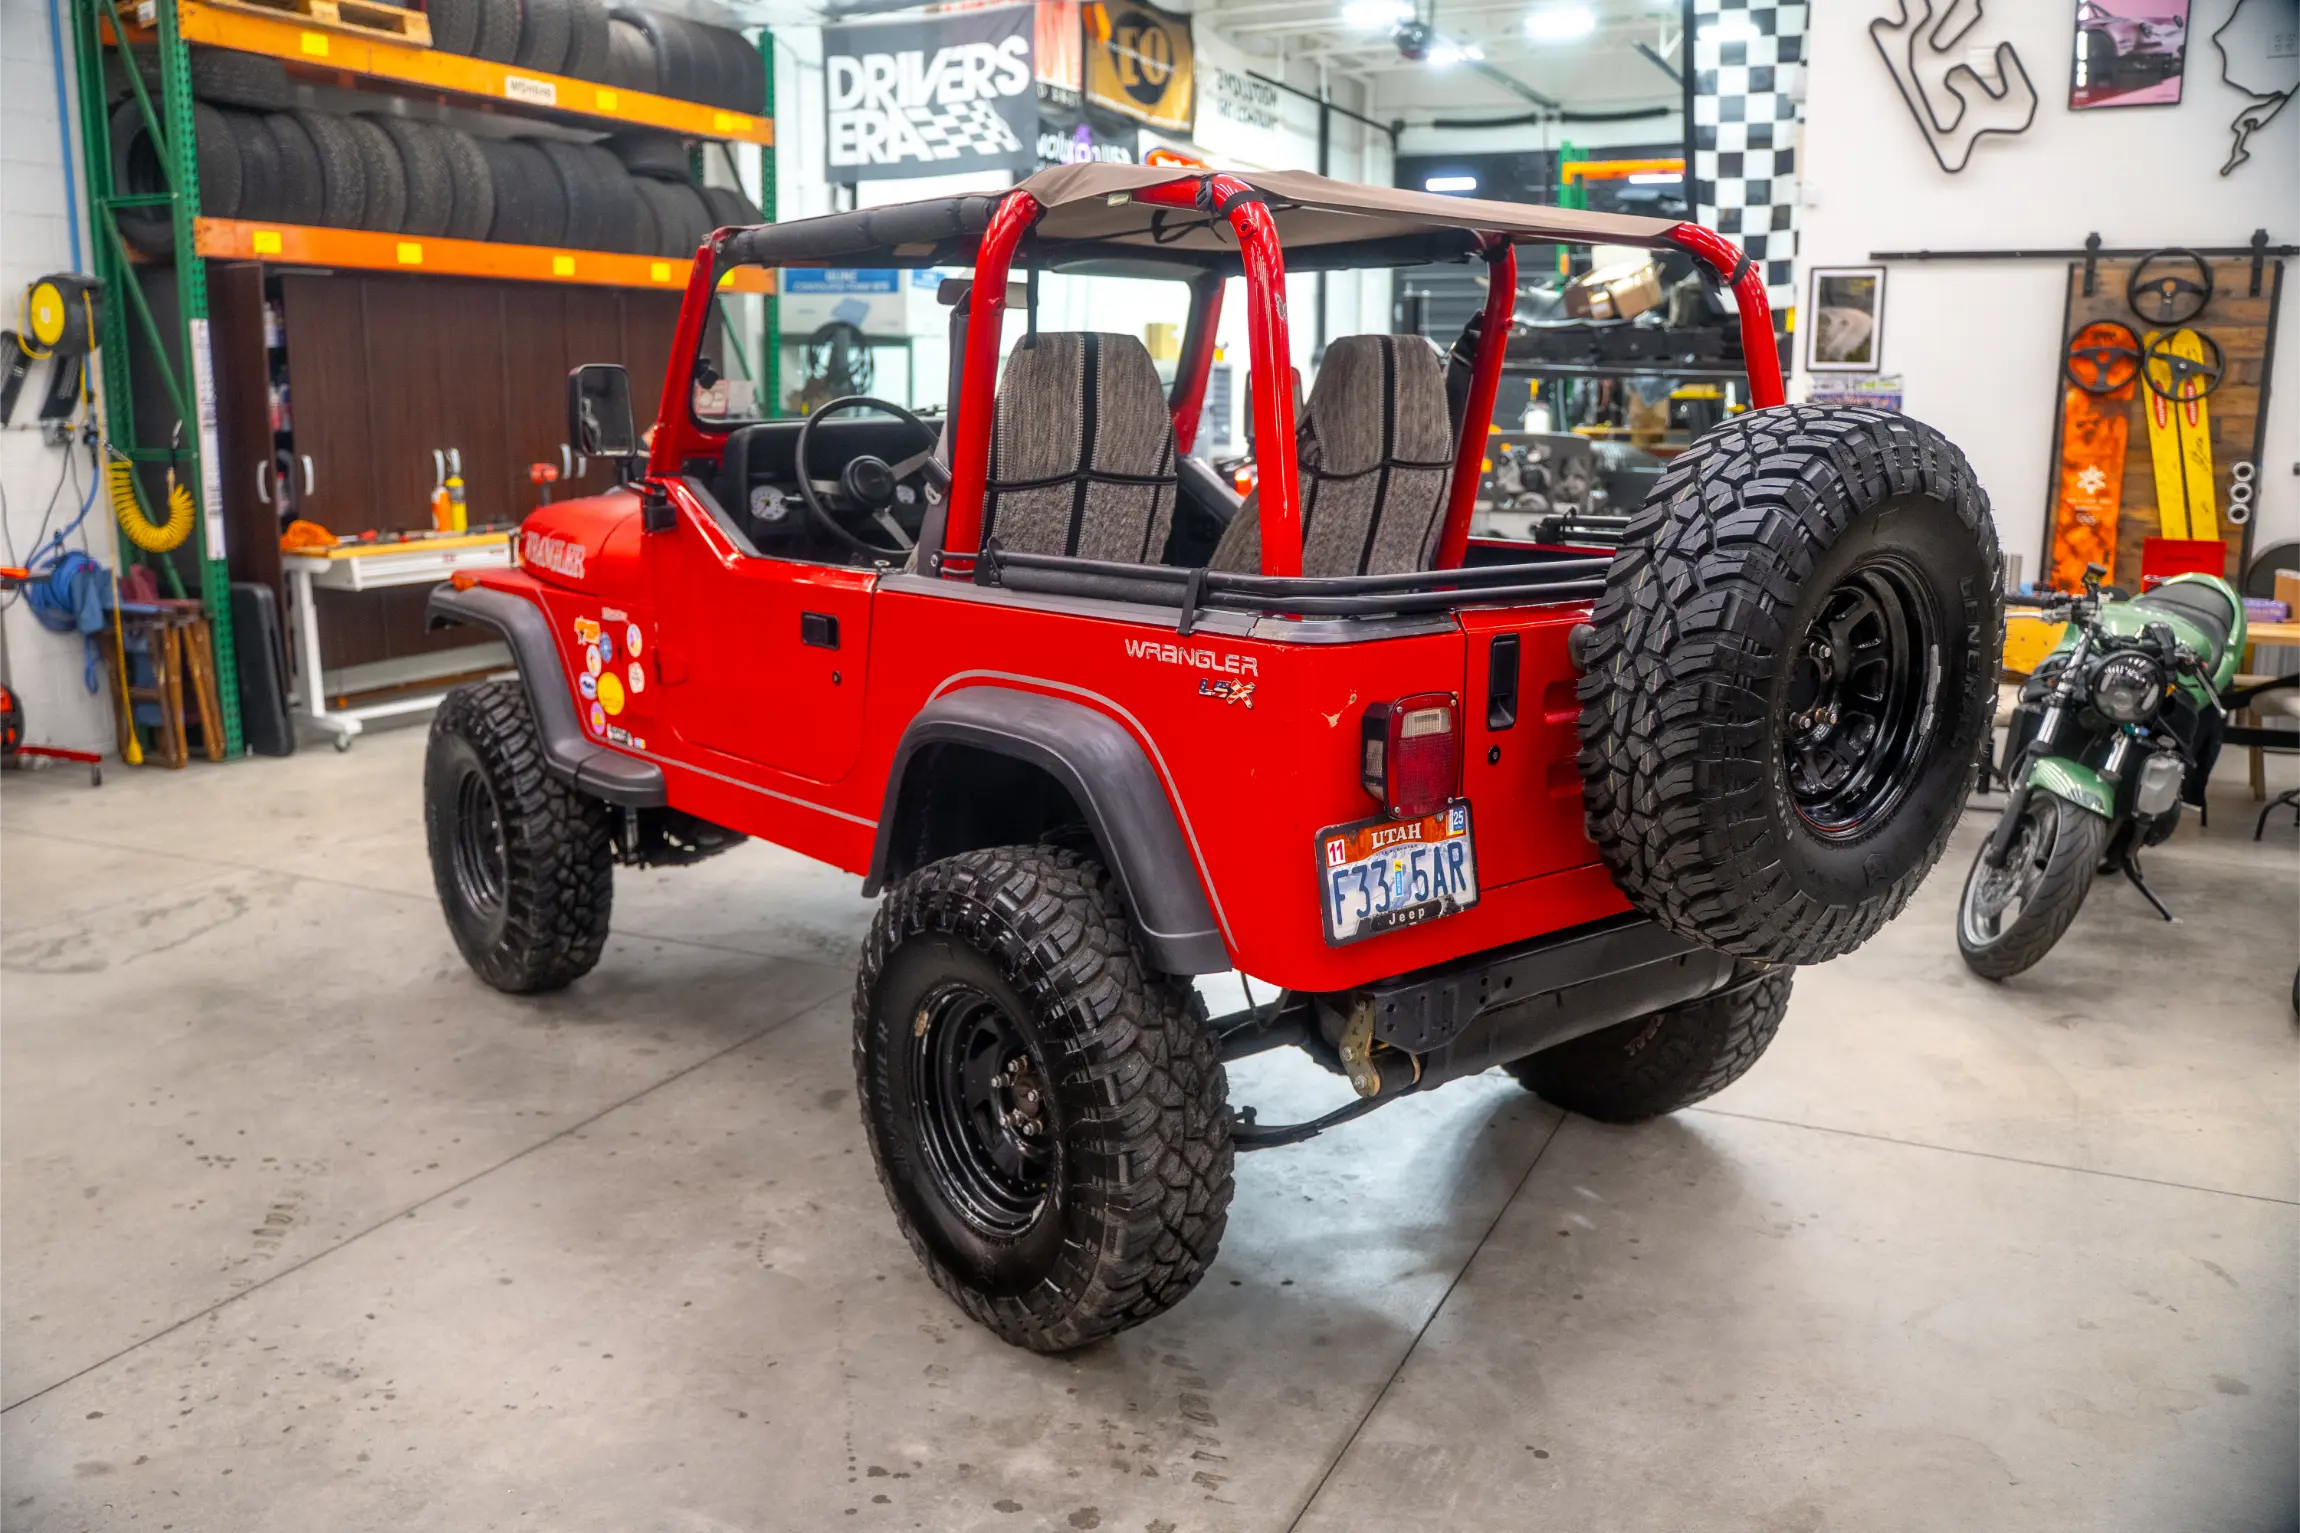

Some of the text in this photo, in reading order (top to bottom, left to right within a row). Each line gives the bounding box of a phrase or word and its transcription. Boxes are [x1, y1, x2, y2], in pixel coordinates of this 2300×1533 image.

[827, 35, 1030, 112] DRIVERS
[828, 107, 935, 167] ERA
[1124, 638, 1259, 677] WRANGLER
[1198, 677, 1256, 709] LSX
[1453, 811, 1464, 825] 25
[1371, 822, 1422, 849] UTAH
[1329, 842, 1344, 866] 11
[1332, 841, 1466, 926] F33 5AR
[1388, 906, 1426, 925] Jeep
